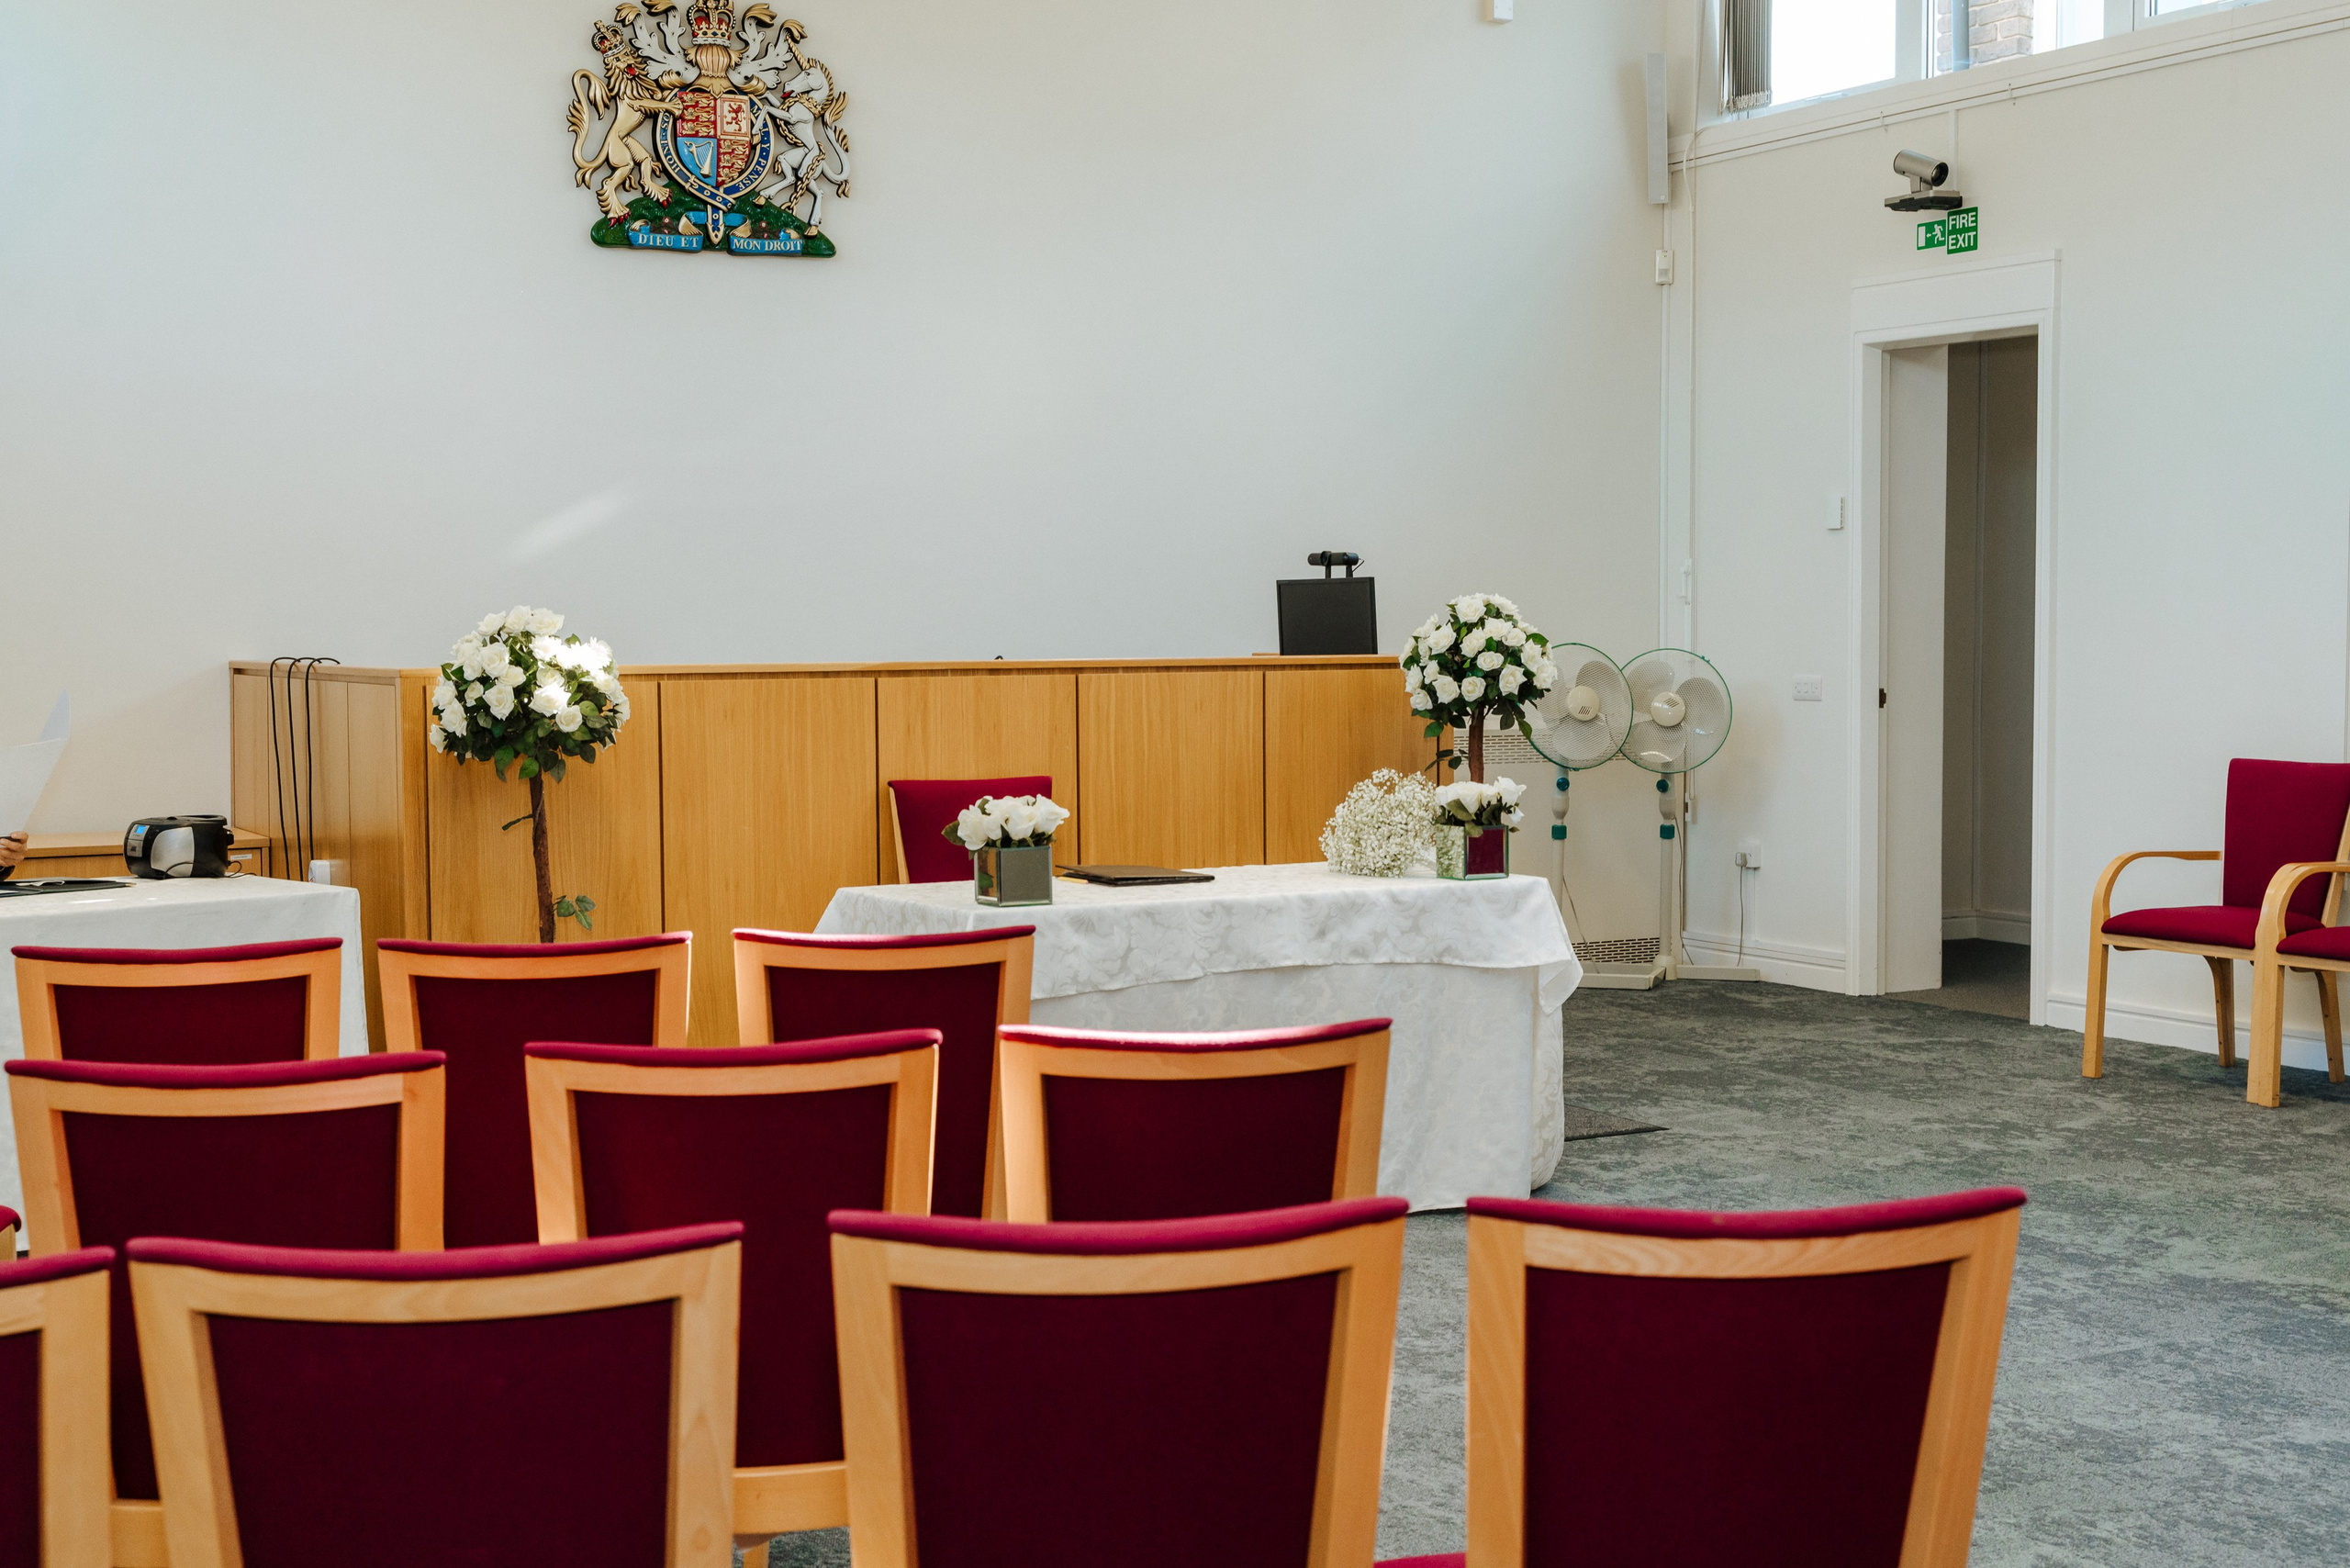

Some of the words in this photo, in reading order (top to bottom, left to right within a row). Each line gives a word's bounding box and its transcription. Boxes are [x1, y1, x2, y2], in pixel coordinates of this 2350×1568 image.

[751, 105, 769, 136] ML
[660, 140, 680, 173] HONI
[735, 157, 767, 190] PENSE
[1949, 212, 1976, 230] FIRE
[638, 233, 675, 247] DIEU
[681, 238, 699, 248] ET
[733, 239, 762, 251] MON
[765, 240, 803, 252] DROIT
[1948, 231, 1976, 250] EXIT
